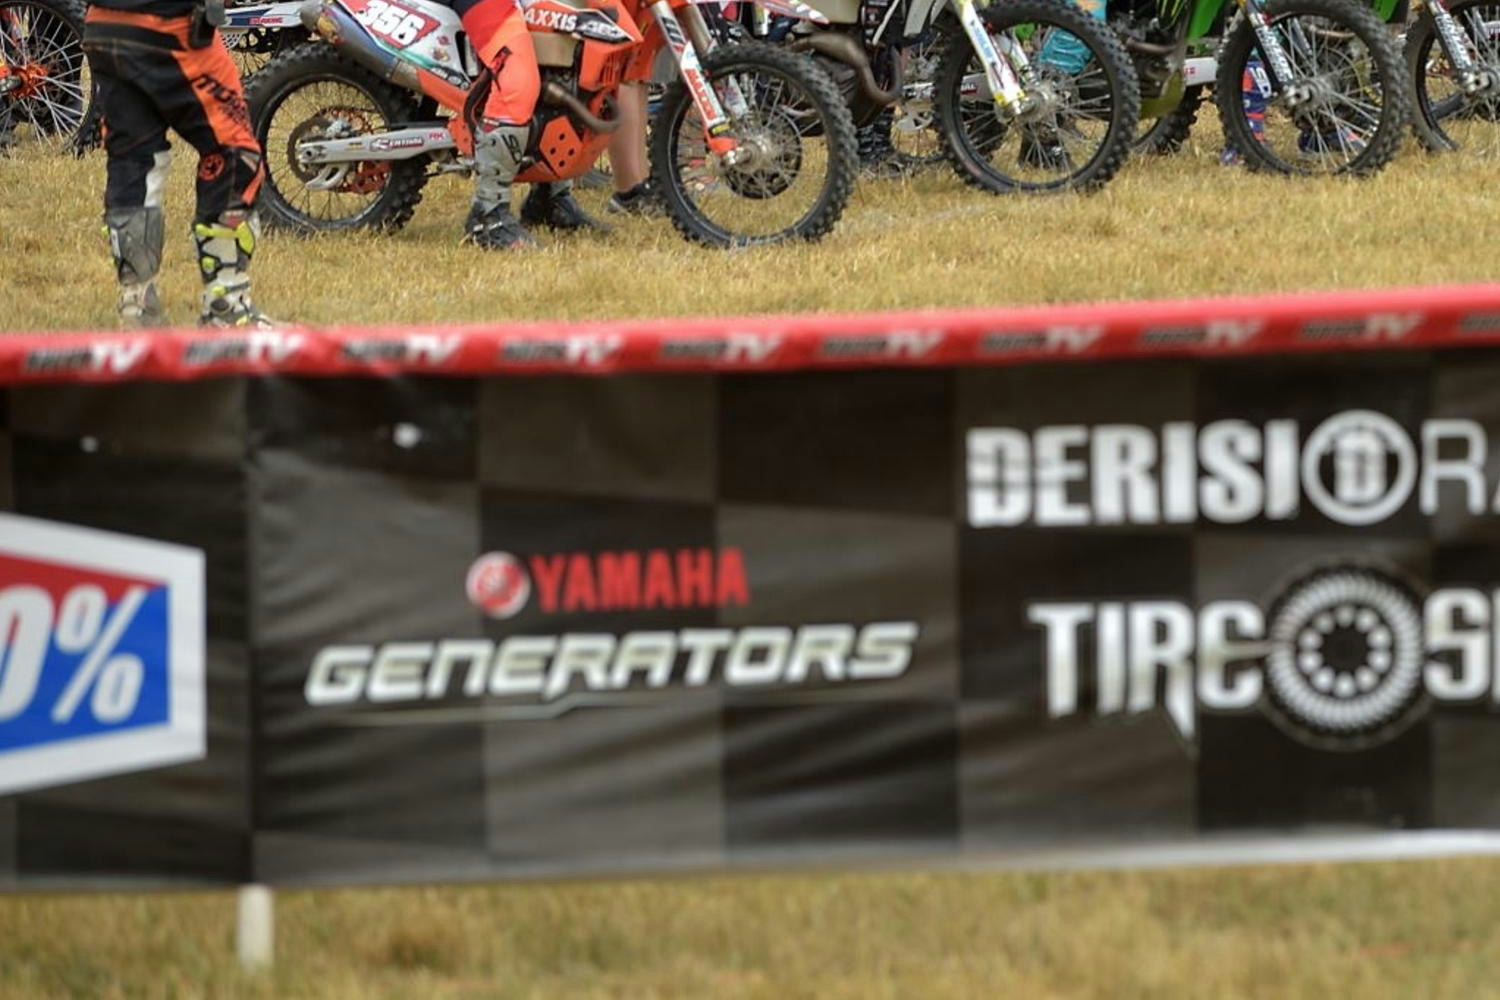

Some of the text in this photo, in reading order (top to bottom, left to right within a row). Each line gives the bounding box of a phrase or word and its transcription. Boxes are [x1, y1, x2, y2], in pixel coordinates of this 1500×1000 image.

[531, 549, 750, 612] YAMAHA
[304, 620, 919, 708] GENERATORS
[1028, 598, 1270, 745] TIRE
